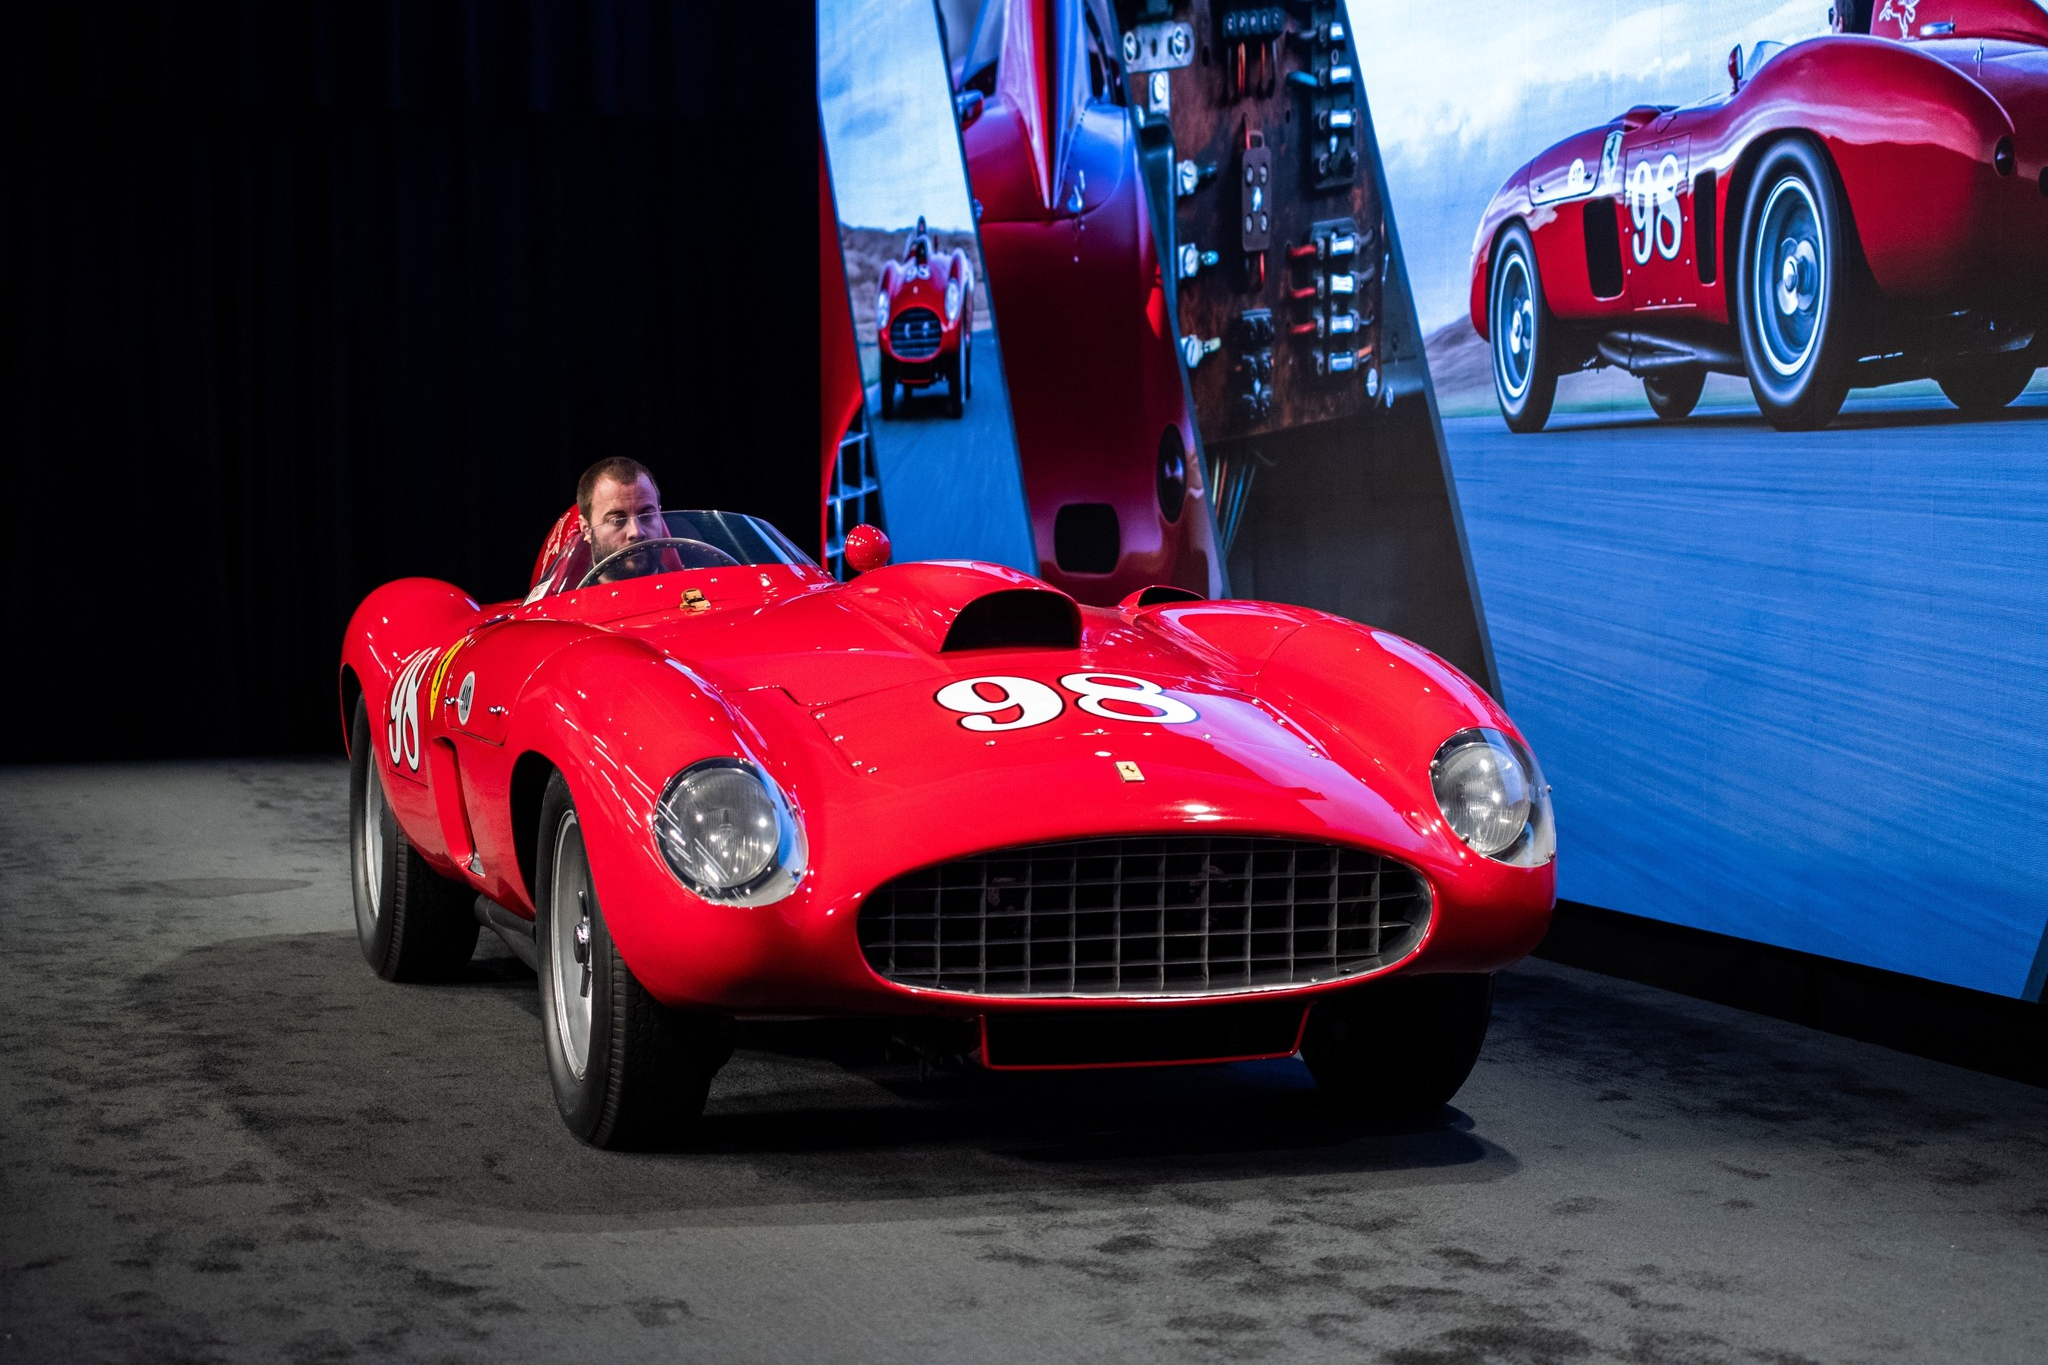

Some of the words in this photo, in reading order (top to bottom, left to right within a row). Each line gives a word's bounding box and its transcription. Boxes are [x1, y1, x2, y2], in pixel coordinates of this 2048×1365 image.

[1631, 153, 1682, 265] 98
[905, 265, 931, 282] 98
[388, 646, 441, 773] 98
[934, 672, 1200, 732] 98
